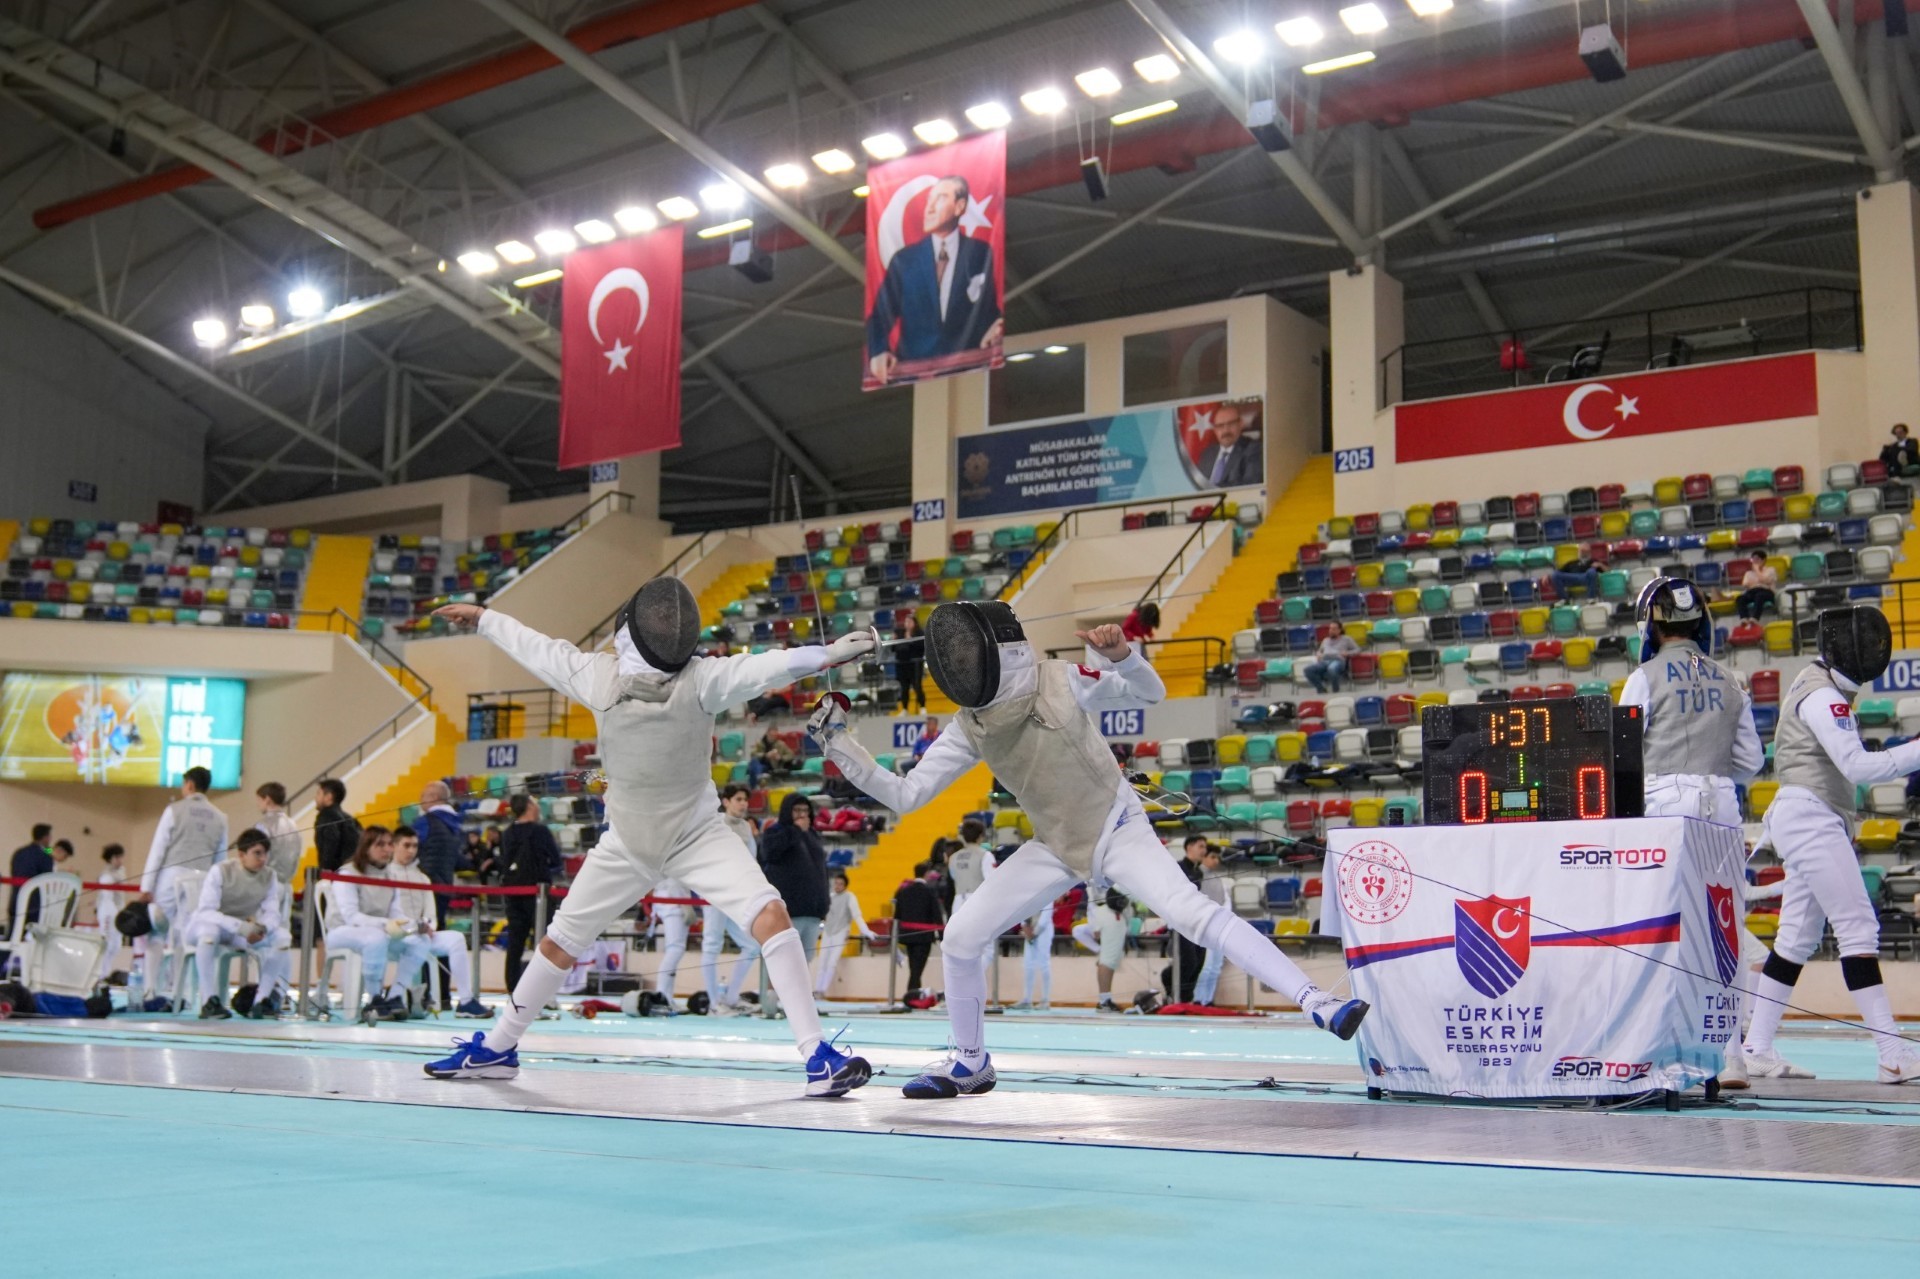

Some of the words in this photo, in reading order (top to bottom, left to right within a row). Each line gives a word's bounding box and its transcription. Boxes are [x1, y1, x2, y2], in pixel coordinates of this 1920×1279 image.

[1029, 434, 1107, 453] MÜSABAKALARA
[1015, 455, 1055, 469] KATILAN
[1057, 450, 1079, 463] TÜM
[1338, 448, 1370, 472] 205
[1005, 469, 1055, 485] ANTRENÖR
[1056, 467, 1069, 478] VE
[1021, 481, 1073, 497] BAŞARILAR
[916, 500, 942, 521] 204
[1675, 683, 1725, 713] TÜR
[1103, 710, 1139, 735] 105
[1491, 707, 1550, 747] 1:37
[489, 746, 515, 766] 104
[1461, 772, 1486, 823] 0
[1579, 767, 1605, 819] 0
[1444, 1004, 1543, 1021] TÜRKİYE
[1446, 1022, 1542, 1039] ESKRİM
[1447, 1044, 1542, 1053] FEDERASYONU
[1479, 1057, 1512, 1066] 1923
